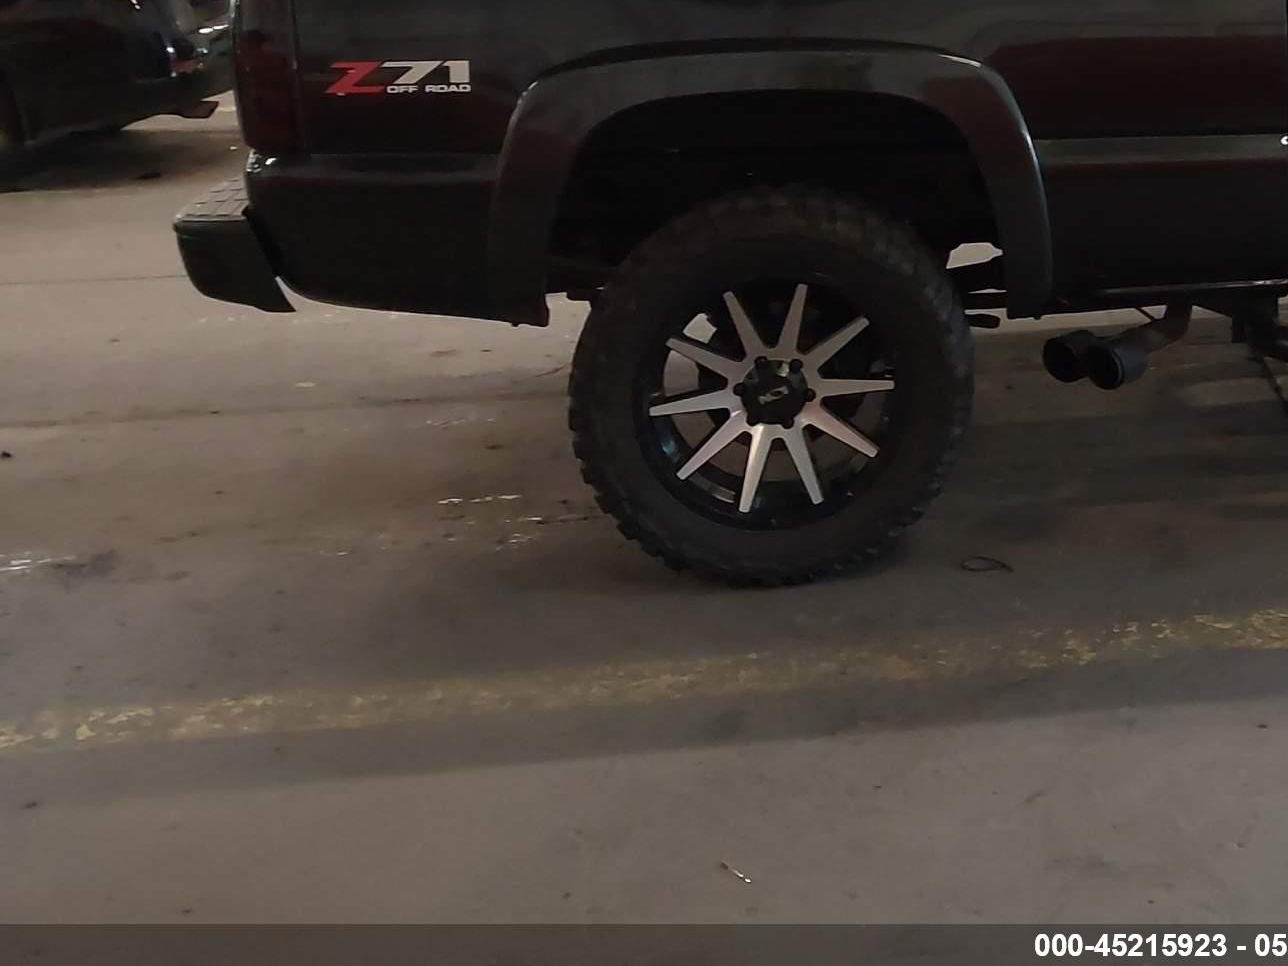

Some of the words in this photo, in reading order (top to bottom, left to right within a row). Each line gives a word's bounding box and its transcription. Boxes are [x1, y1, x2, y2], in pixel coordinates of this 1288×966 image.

[324, 60, 471, 94] Z71
[386, 85, 419, 94] OFF
[425, 84, 472, 94] ROAD
